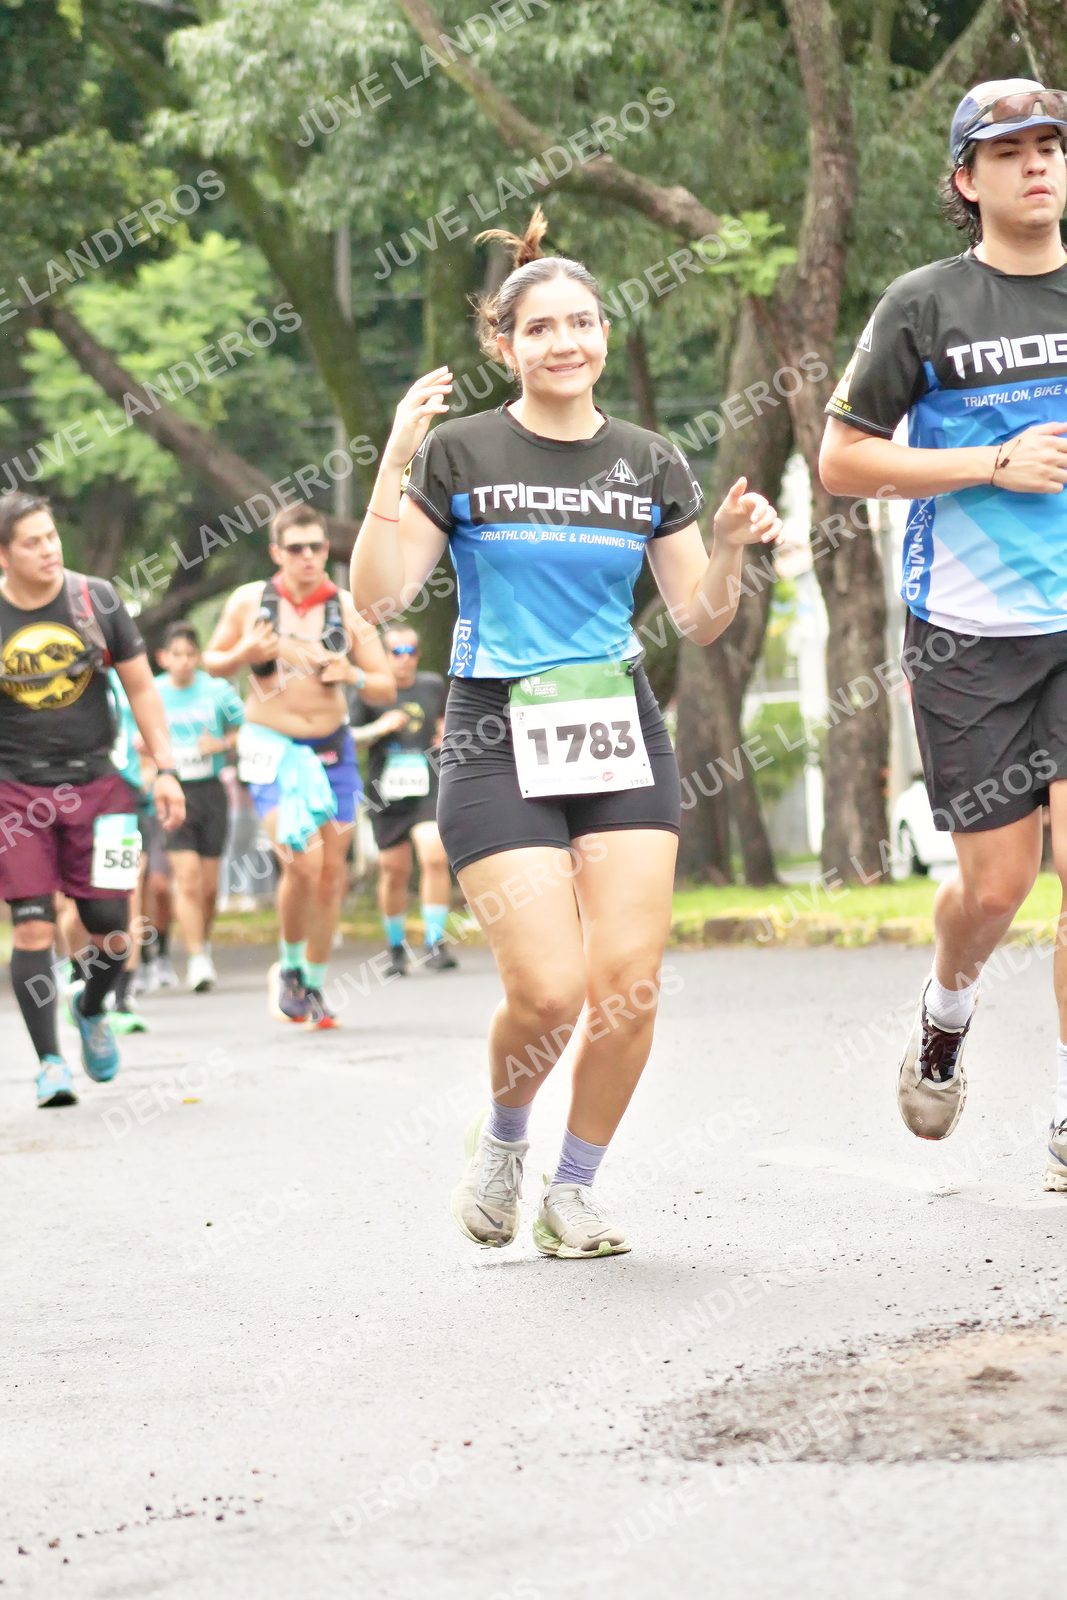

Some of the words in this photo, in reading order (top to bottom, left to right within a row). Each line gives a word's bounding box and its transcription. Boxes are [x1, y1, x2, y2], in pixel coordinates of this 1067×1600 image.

[963, 389, 1031, 408] TRIATHLON,
[1034, 384, 1063, 398] BIKE
[473, 482, 653, 521] TRIDENTE
[480, 530, 539, 542] TRIATHLON,
[541, 532, 567, 543] BIKE
[570, 533, 577, 543] &
[579, 533, 626, 548] RUNNING
[527, 720, 636, 765] 1783
[103, 849, 141, 869] 58
